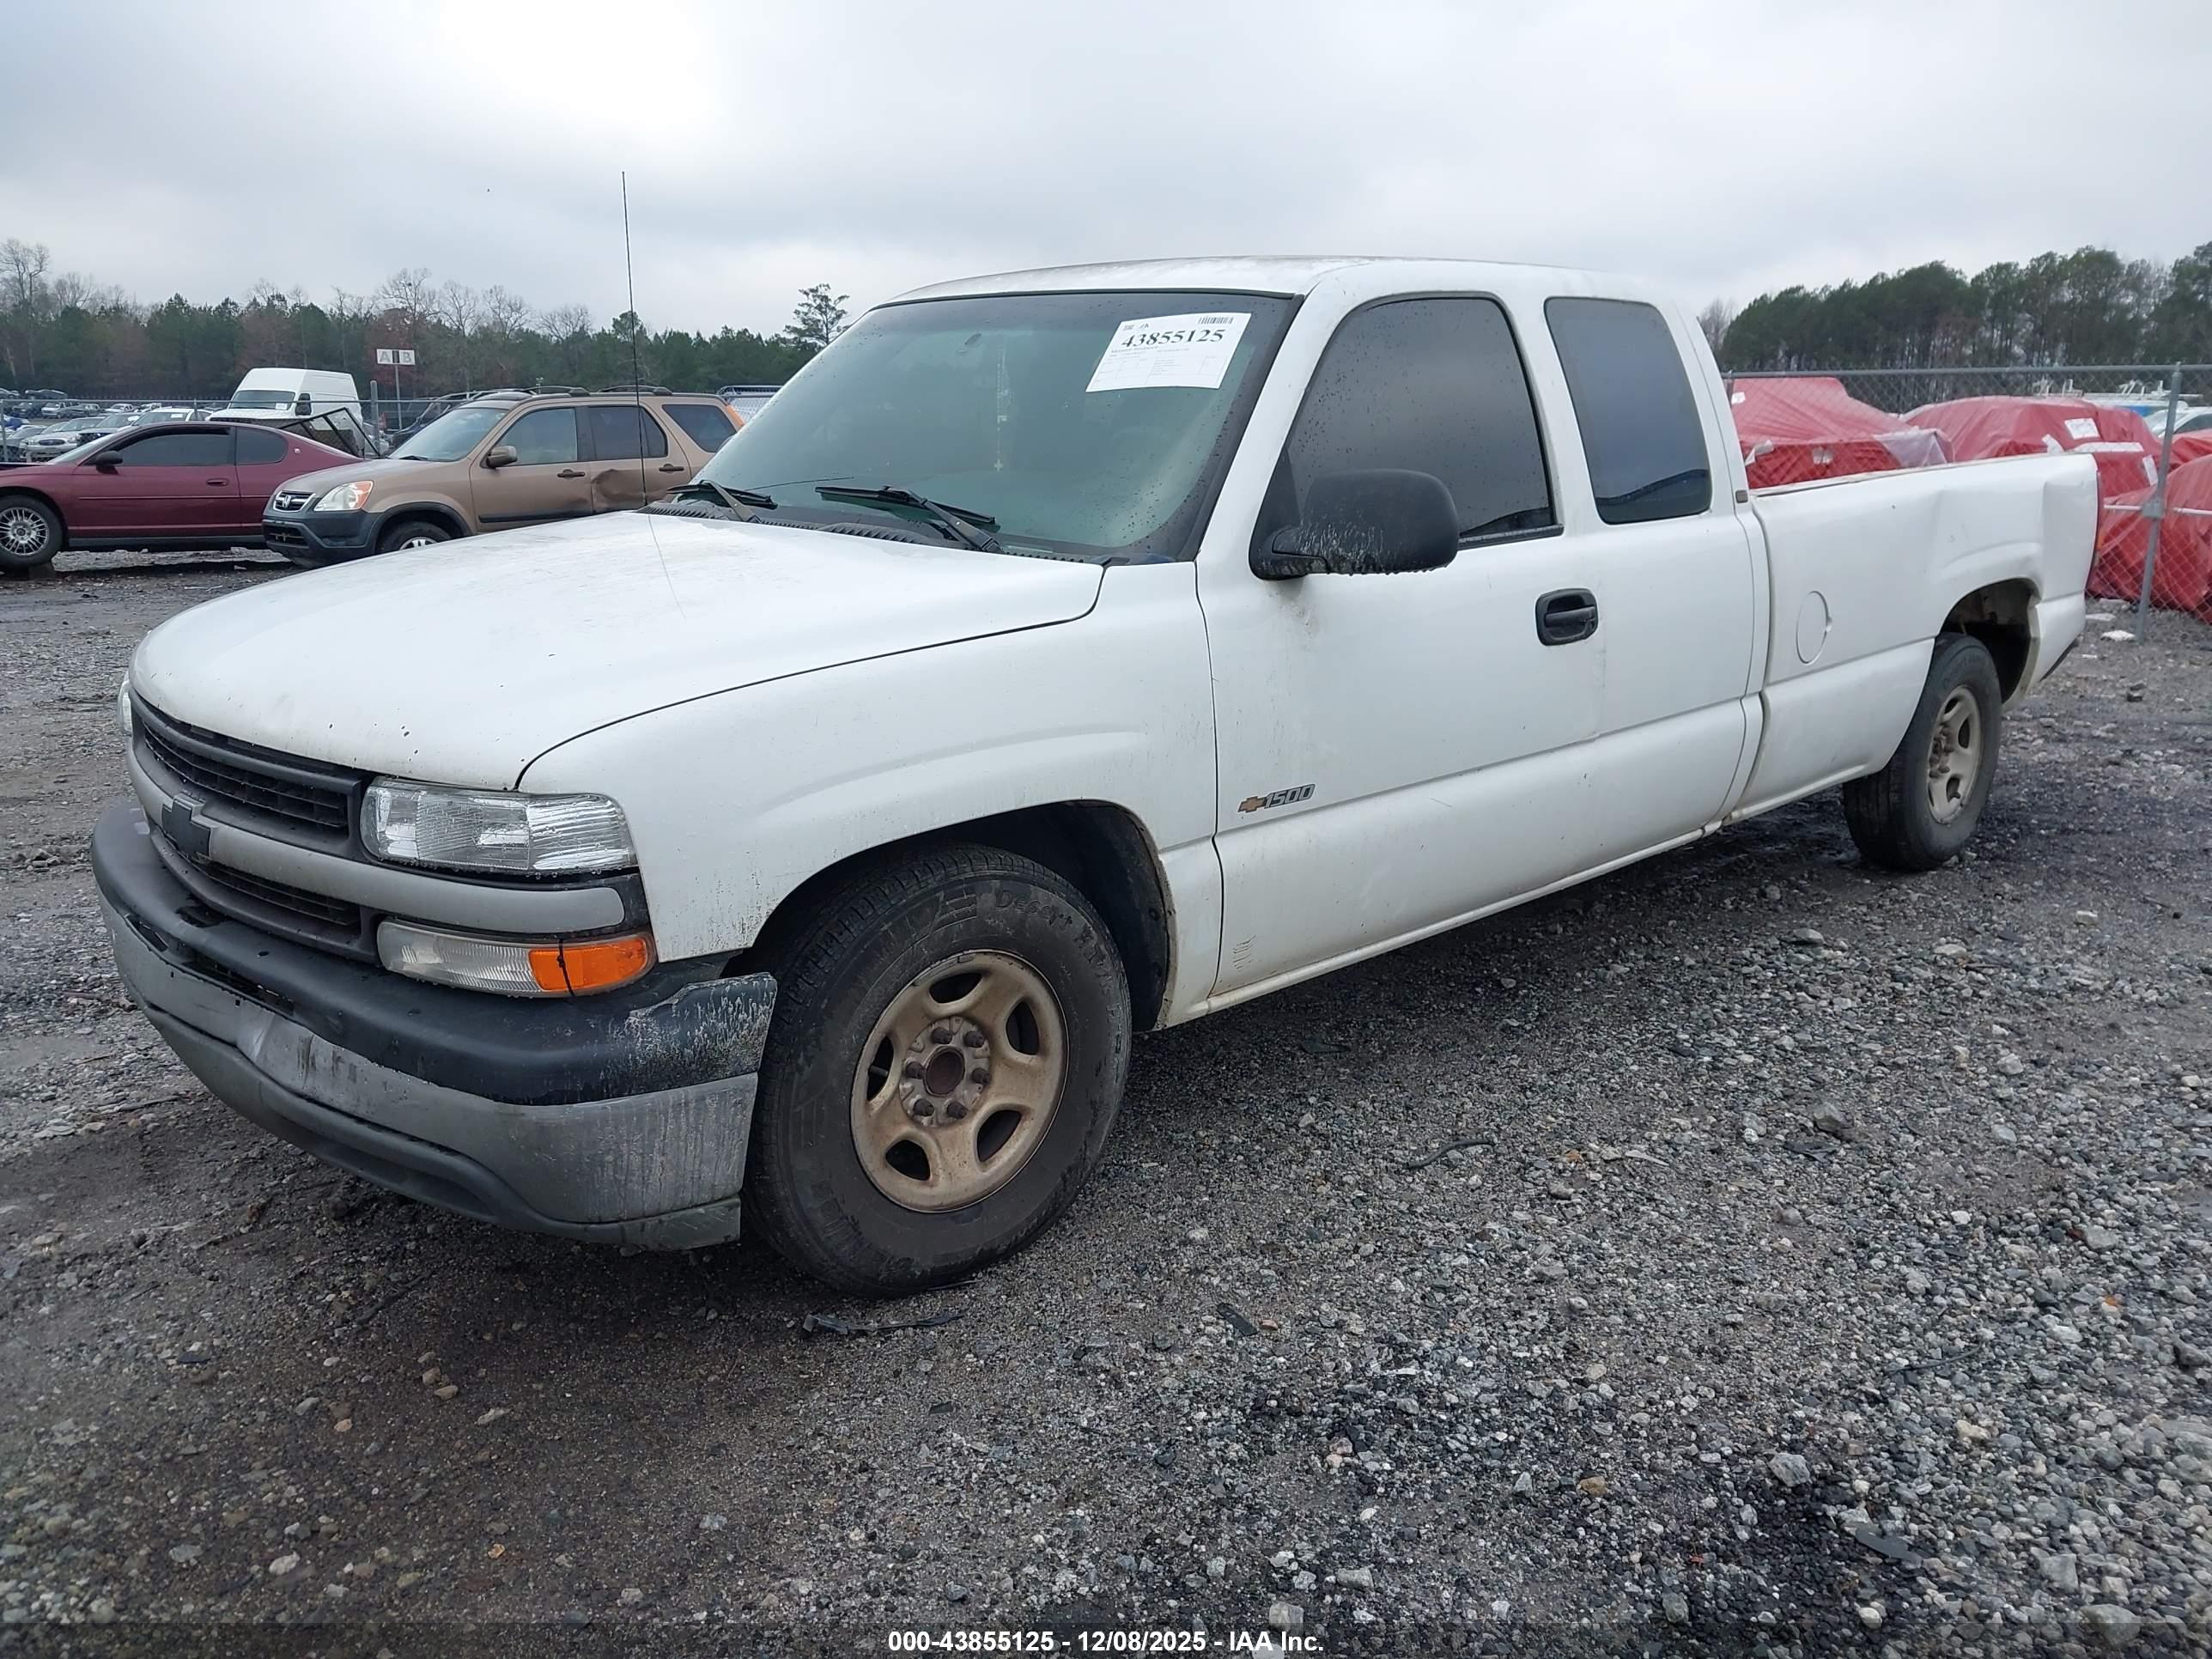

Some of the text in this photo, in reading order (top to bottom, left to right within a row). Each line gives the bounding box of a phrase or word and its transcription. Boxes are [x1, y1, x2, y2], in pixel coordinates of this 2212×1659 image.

[1121, 329, 1226, 348] 43855125
[380, 351, 412, 362] A B
[1263, 784, 1316, 809] 1500
